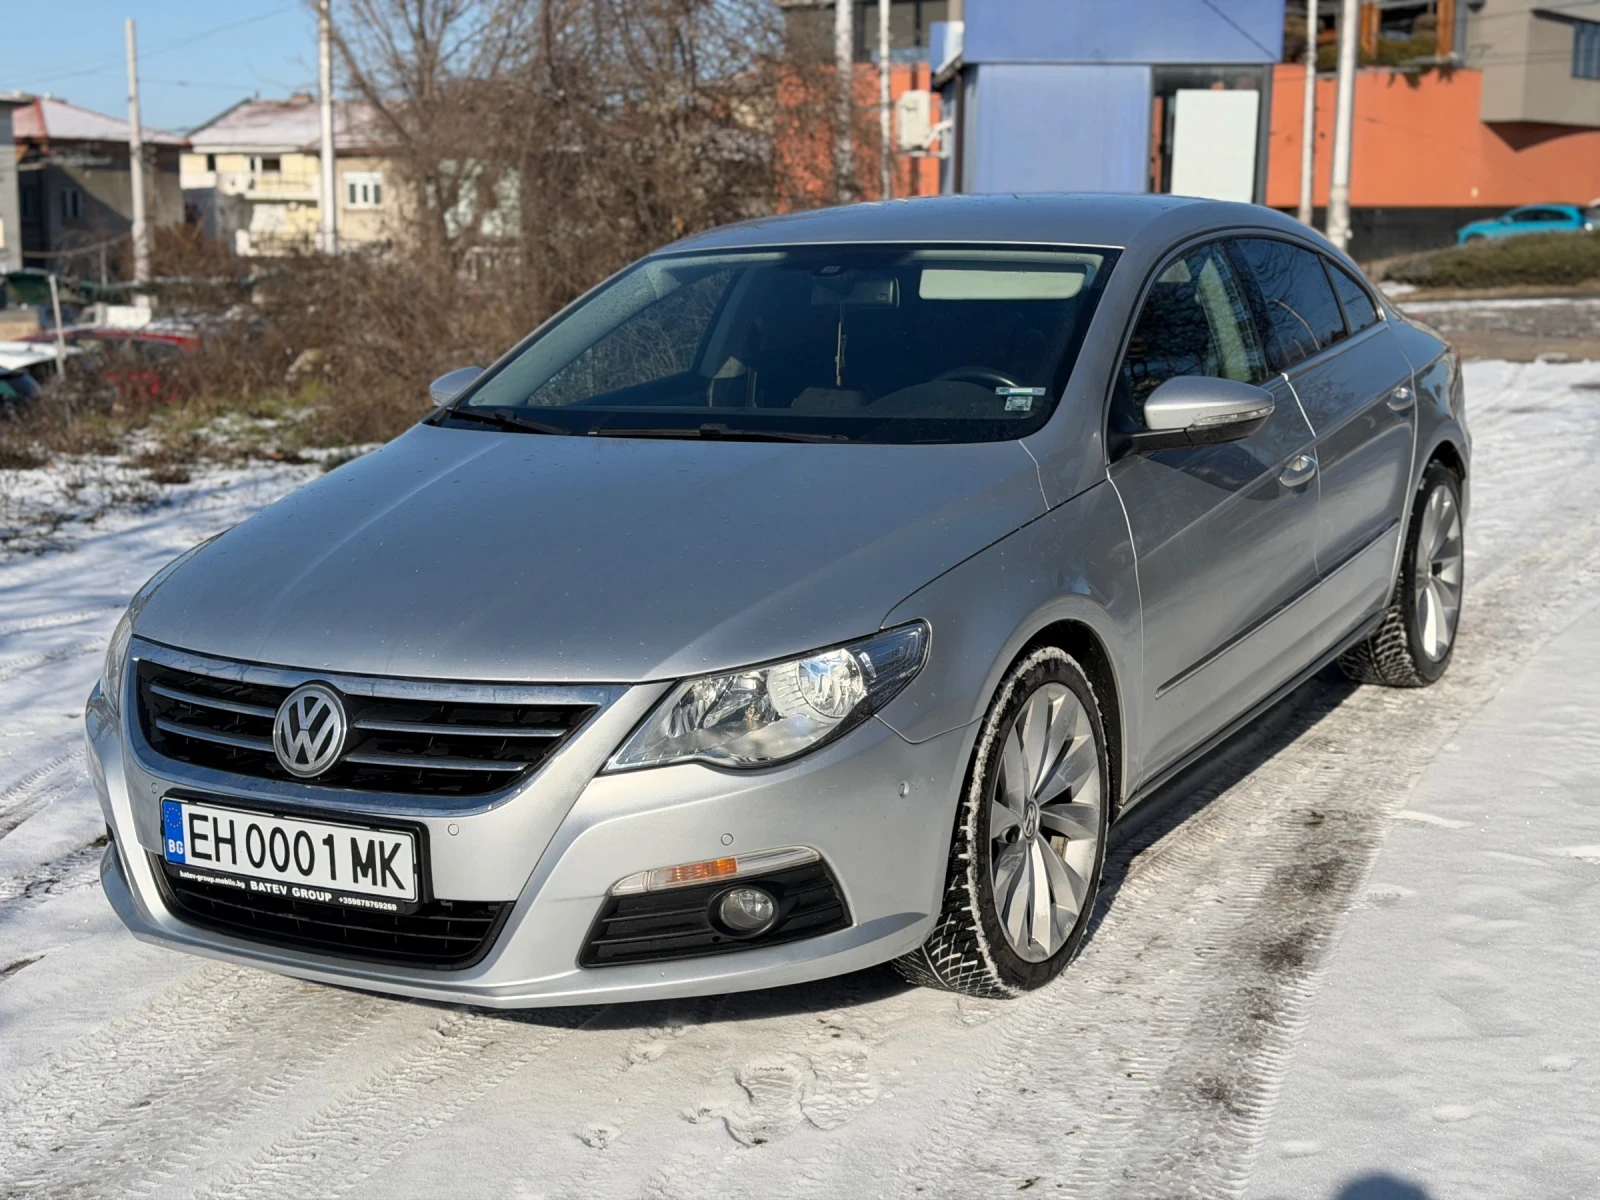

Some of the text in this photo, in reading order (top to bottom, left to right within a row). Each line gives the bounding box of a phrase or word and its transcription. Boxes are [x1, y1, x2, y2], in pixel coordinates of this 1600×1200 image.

[168, 839, 184, 854] BG
[188, 813, 406, 890] EH 0001 MK
[179, 870, 397, 911] batev-group.mobile.bg BATEV GROUP +359878769269
